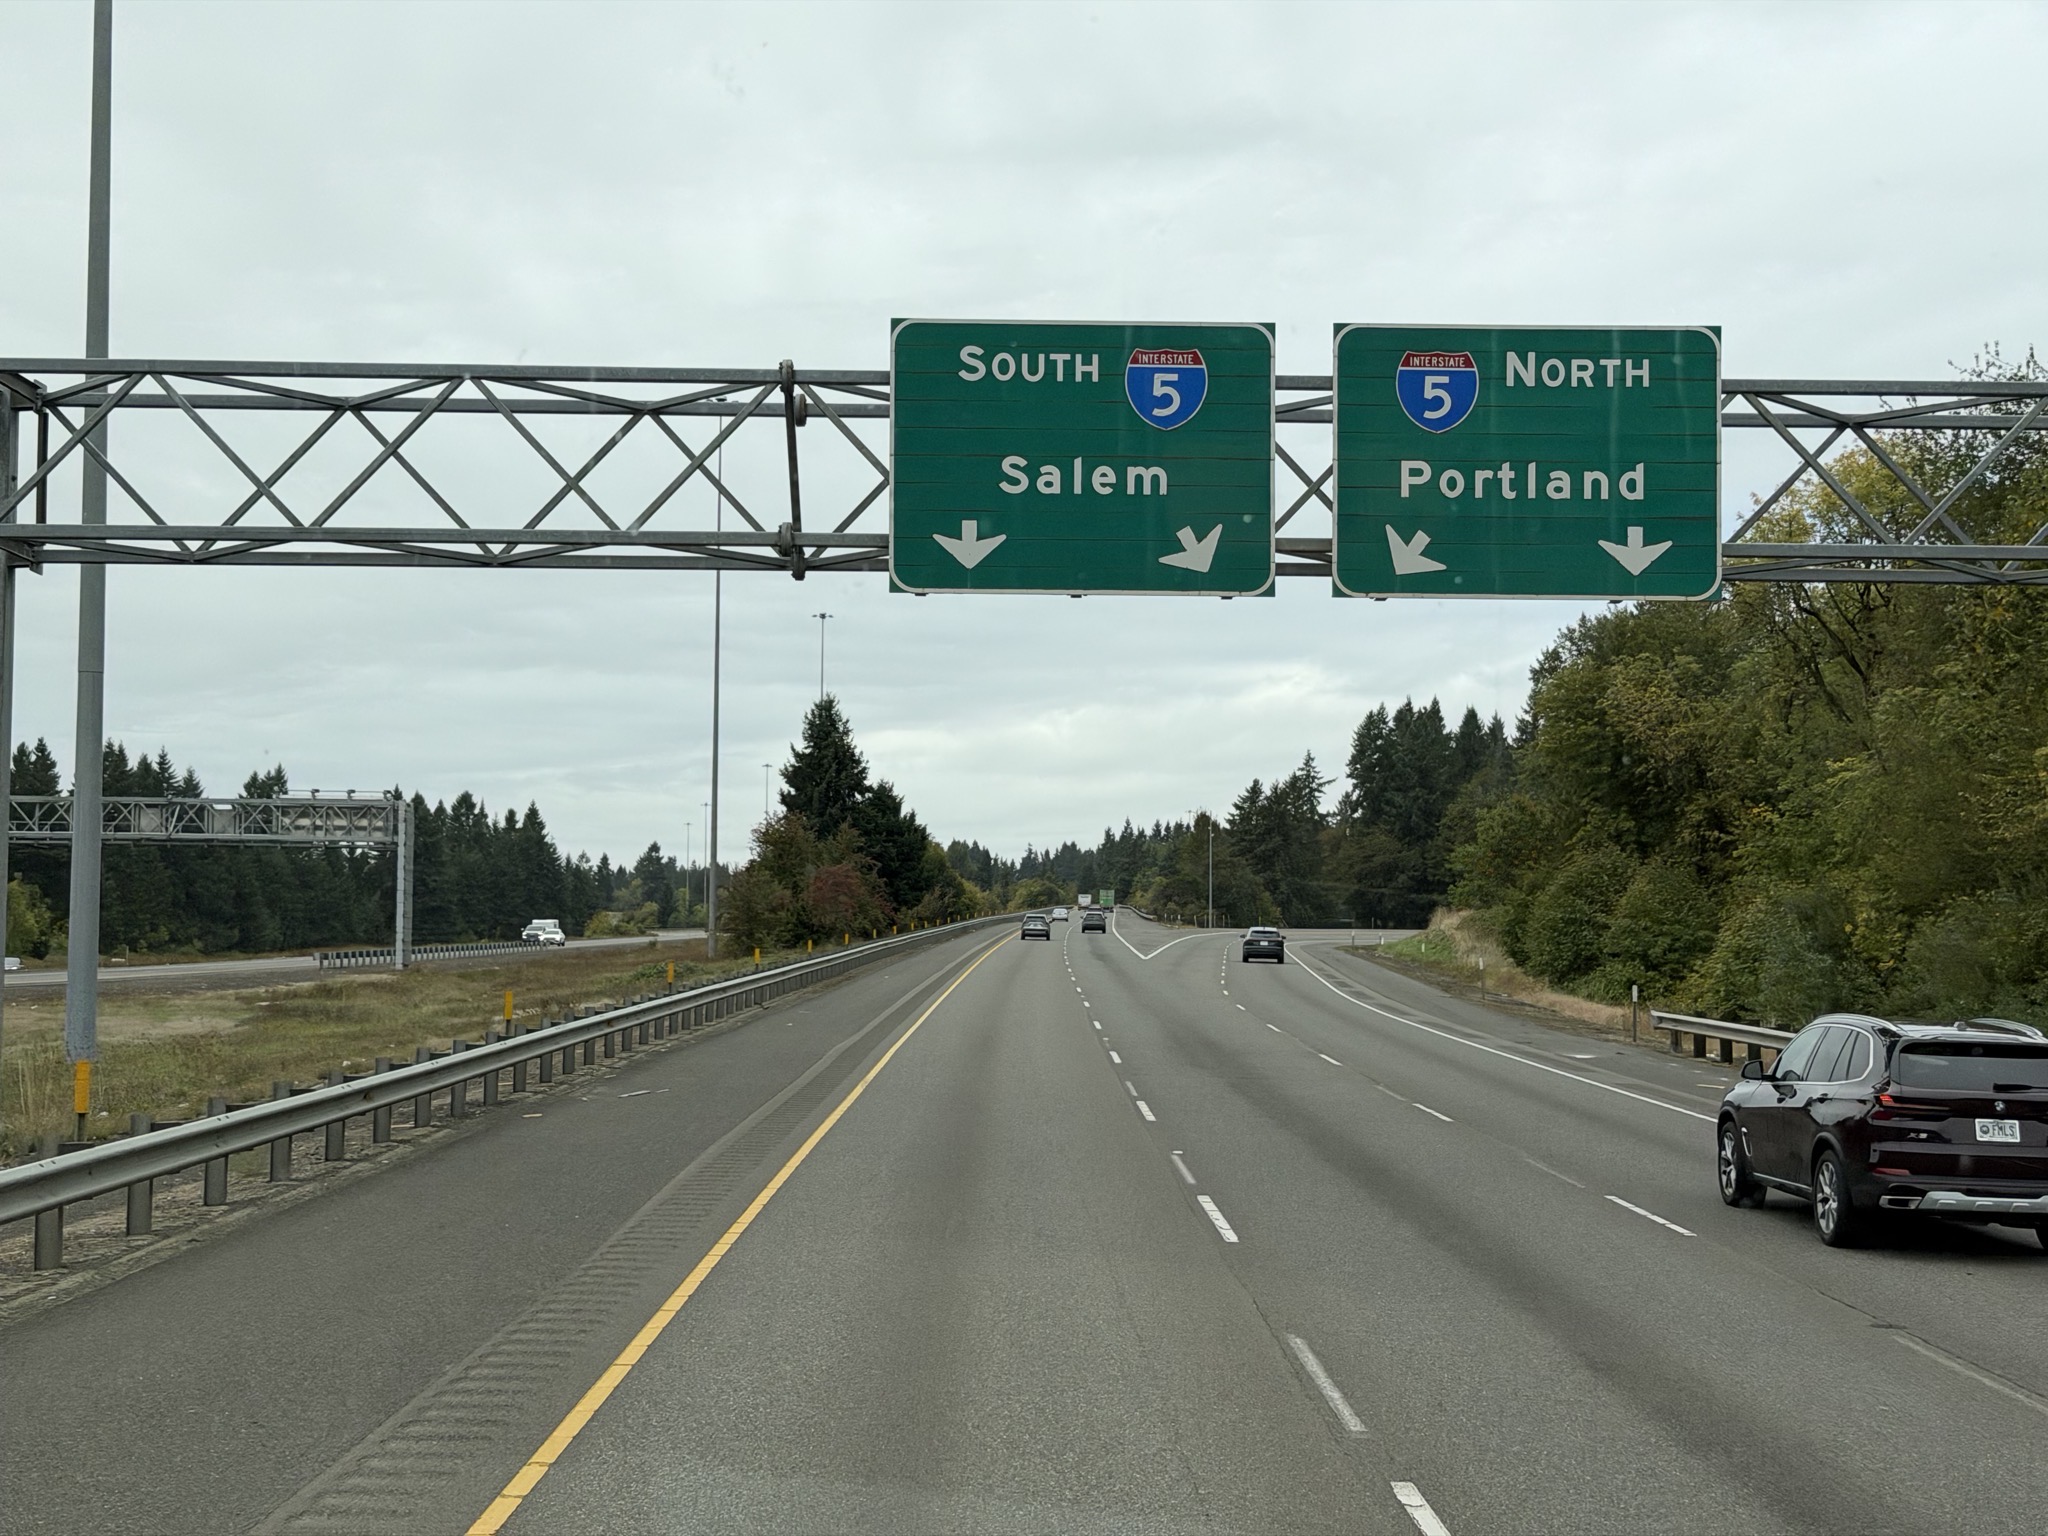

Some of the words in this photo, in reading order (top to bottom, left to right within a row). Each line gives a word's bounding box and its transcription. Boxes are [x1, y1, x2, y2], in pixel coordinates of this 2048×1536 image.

[958, 345, 1099, 382] SOUTH
[1138, 353, 1194, 365] INTERSTATE
[1409, 356, 1466, 368] INTERSTATE
[1506, 351, 1650, 388] NORTH
[1151, 373, 1181, 417] 5
[1422, 375, 1452, 419] 5
[998, 455, 1168, 496] Salem
[1400, 460, 1645, 500] Portland
